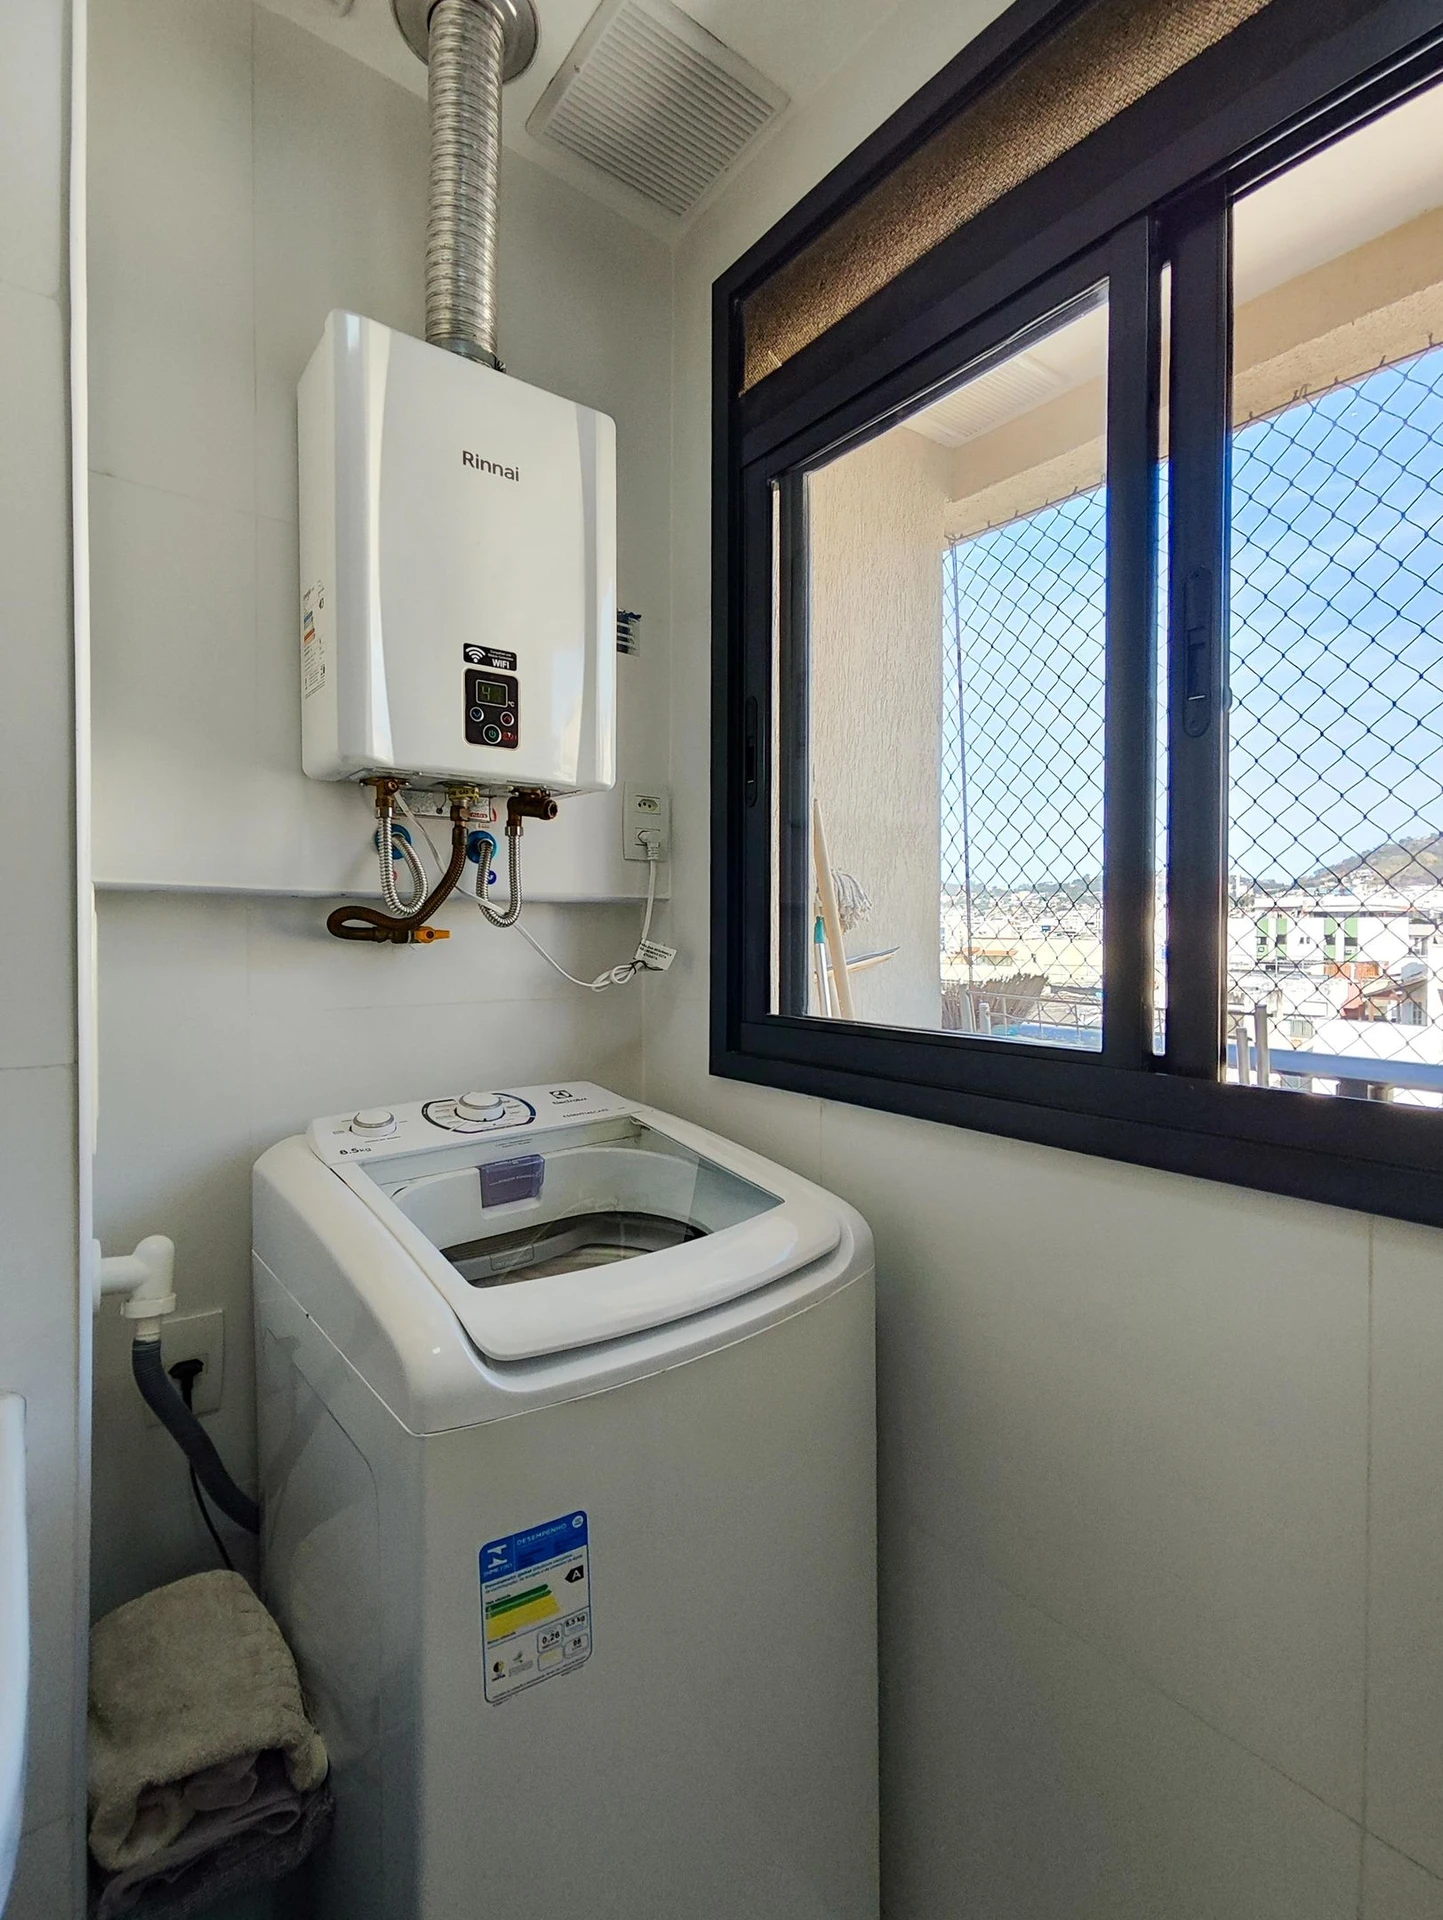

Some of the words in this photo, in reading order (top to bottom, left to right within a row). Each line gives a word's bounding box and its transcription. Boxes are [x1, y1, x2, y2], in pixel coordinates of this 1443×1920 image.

[462, 450, 519, 482] Rinnai
[516, 1523, 567, 1546] DESEMPENHO
[571, 1569, 581, 1580] A
